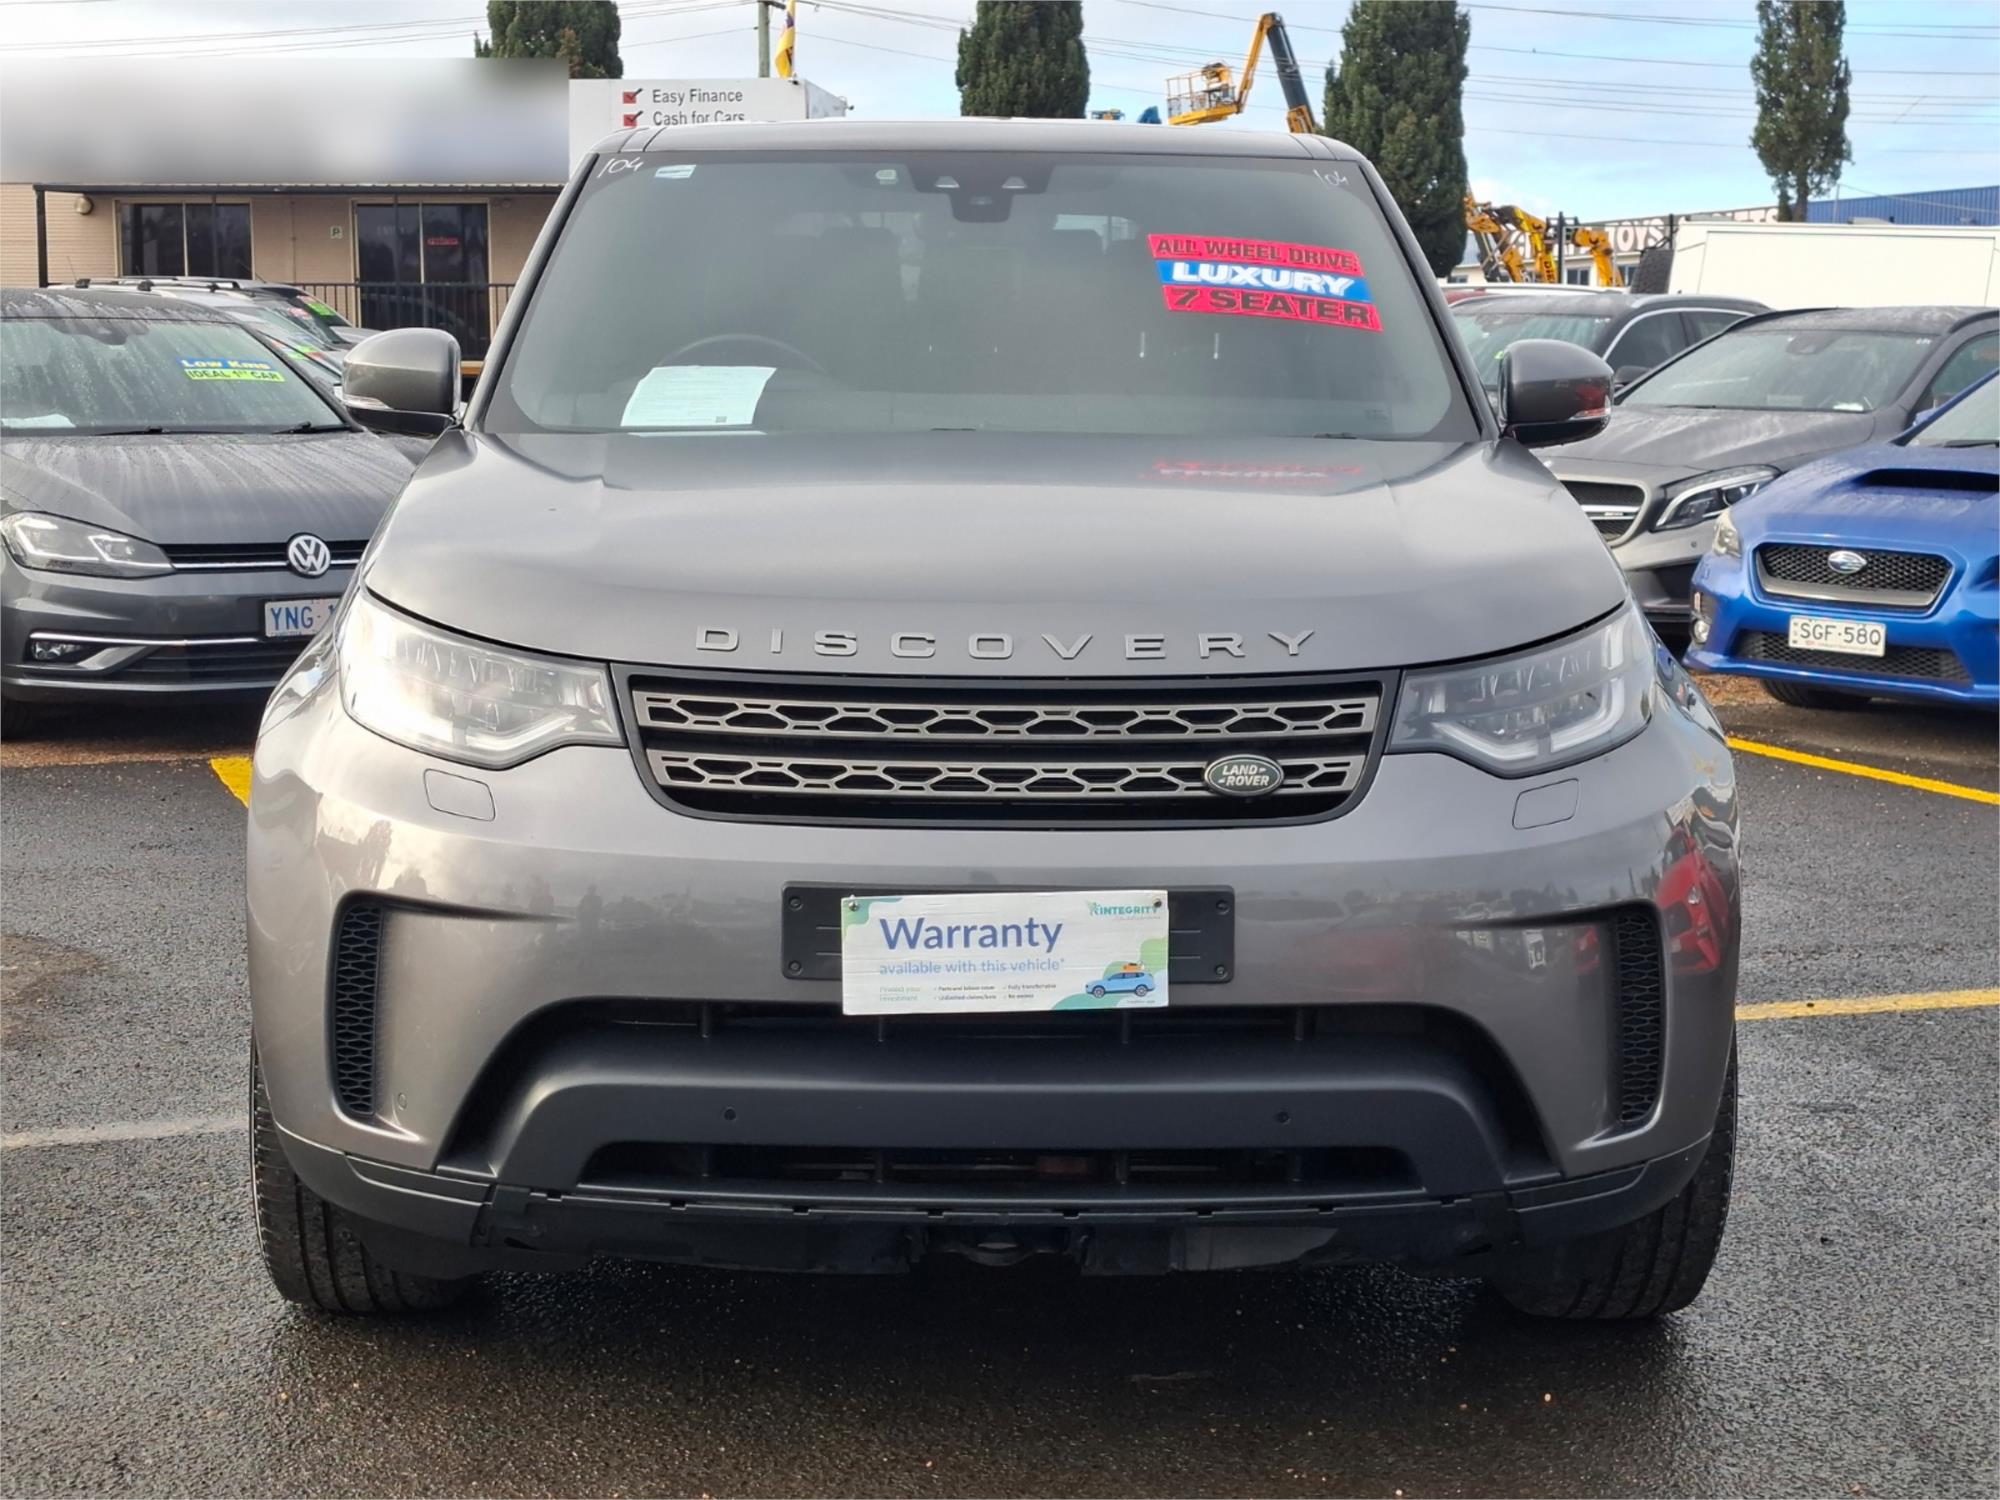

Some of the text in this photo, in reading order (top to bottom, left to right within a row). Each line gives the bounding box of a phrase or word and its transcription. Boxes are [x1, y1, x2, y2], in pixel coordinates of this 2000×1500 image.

[652, 88, 743, 106] Easy Finance
[653, 110, 745, 126] Cash for Cars
[597, 156, 644, 178] 104
[1605, 218, 1665, 251] TOYS
[1157, 238, 1355, 269] ALL WHEEL DRIVE
[1172, 261, 1354, 297] LUXURY
[1171, 288, 1371, 324] 7 SEATER
[181, 358, 223, 368] Low
[189, 369, 231, 378] IDEAL
[254, 371, 280, 380] CAR
[695, 626, 1314, 660] DISCOVERY
[1222, 764, 1258, 776] LAND
[1226, 775, 1270, 786] ROVER
[1099, 905, 1158, 915] INTEGRITY
[879, 917, 1063, 953] Warranty
[879, 960, 942, 976] available
[945, 960, 977, 974] with
[981, 959, 1007, 973] this
